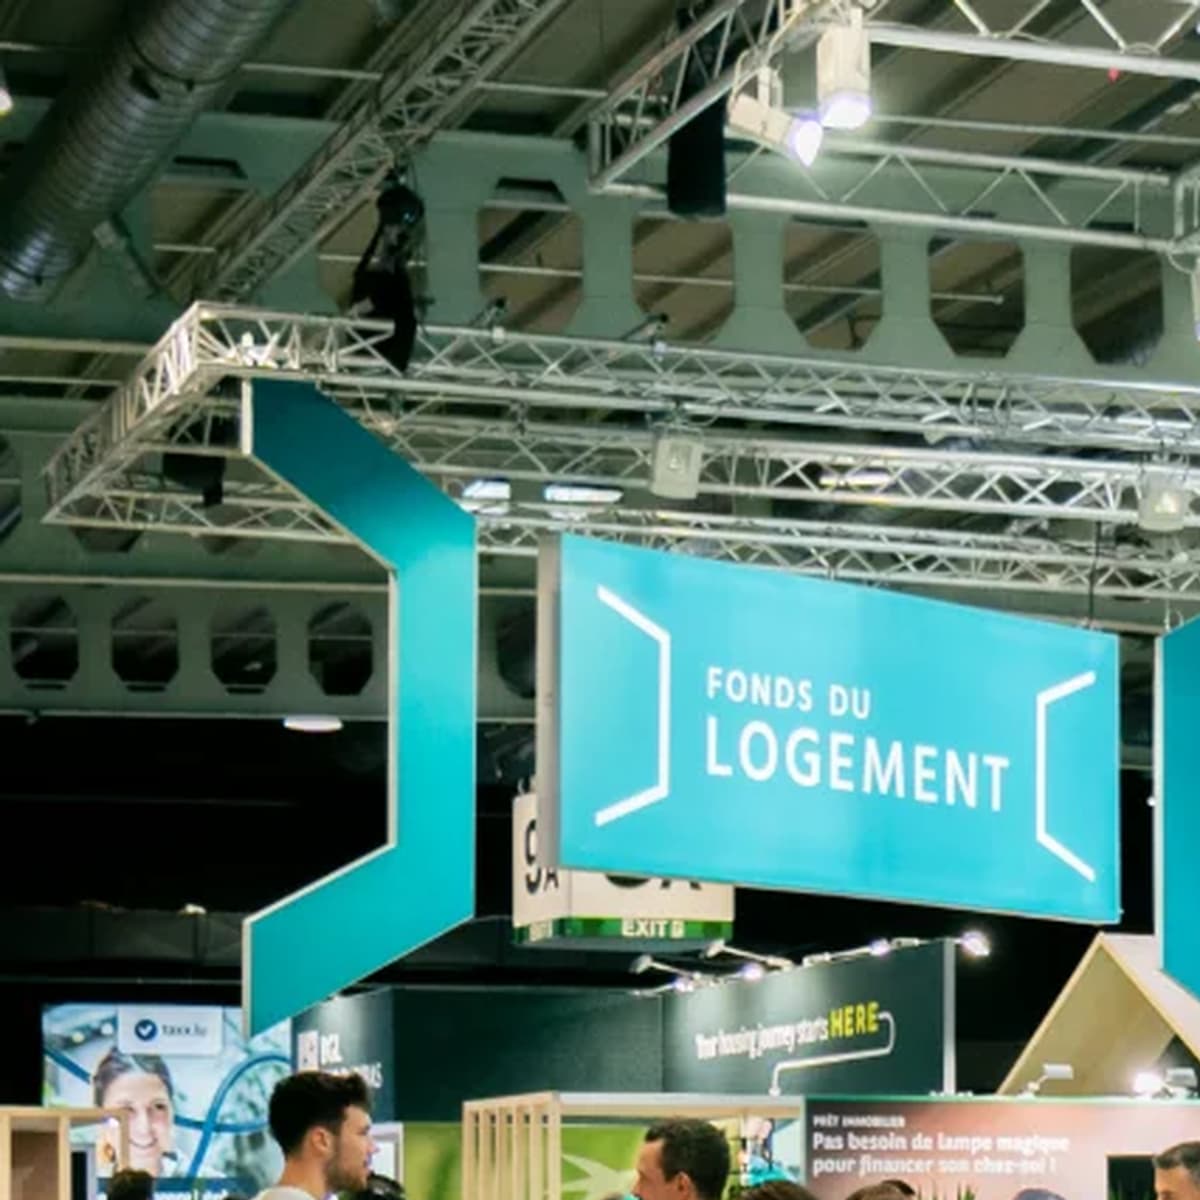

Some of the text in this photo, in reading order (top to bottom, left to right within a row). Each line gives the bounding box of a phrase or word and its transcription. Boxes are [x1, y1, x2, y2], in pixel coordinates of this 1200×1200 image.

[706, 665, 872, 720] FONDS DU
[706, 714, 1010, 812] LOGEMENT
[621, 918, 668, 938] EXIT
[829, 1001, 879, 1038] HERE
[812, 1131, 844, 1150] Pas
[847, 1131, 907, 1150] besoin
[911, 1131, 934, 1150] de
[937, 1132, 993, 1156] lampe
[812, 1157, 857, 1178] pour
[858, 1154, 934, 1178] financer
